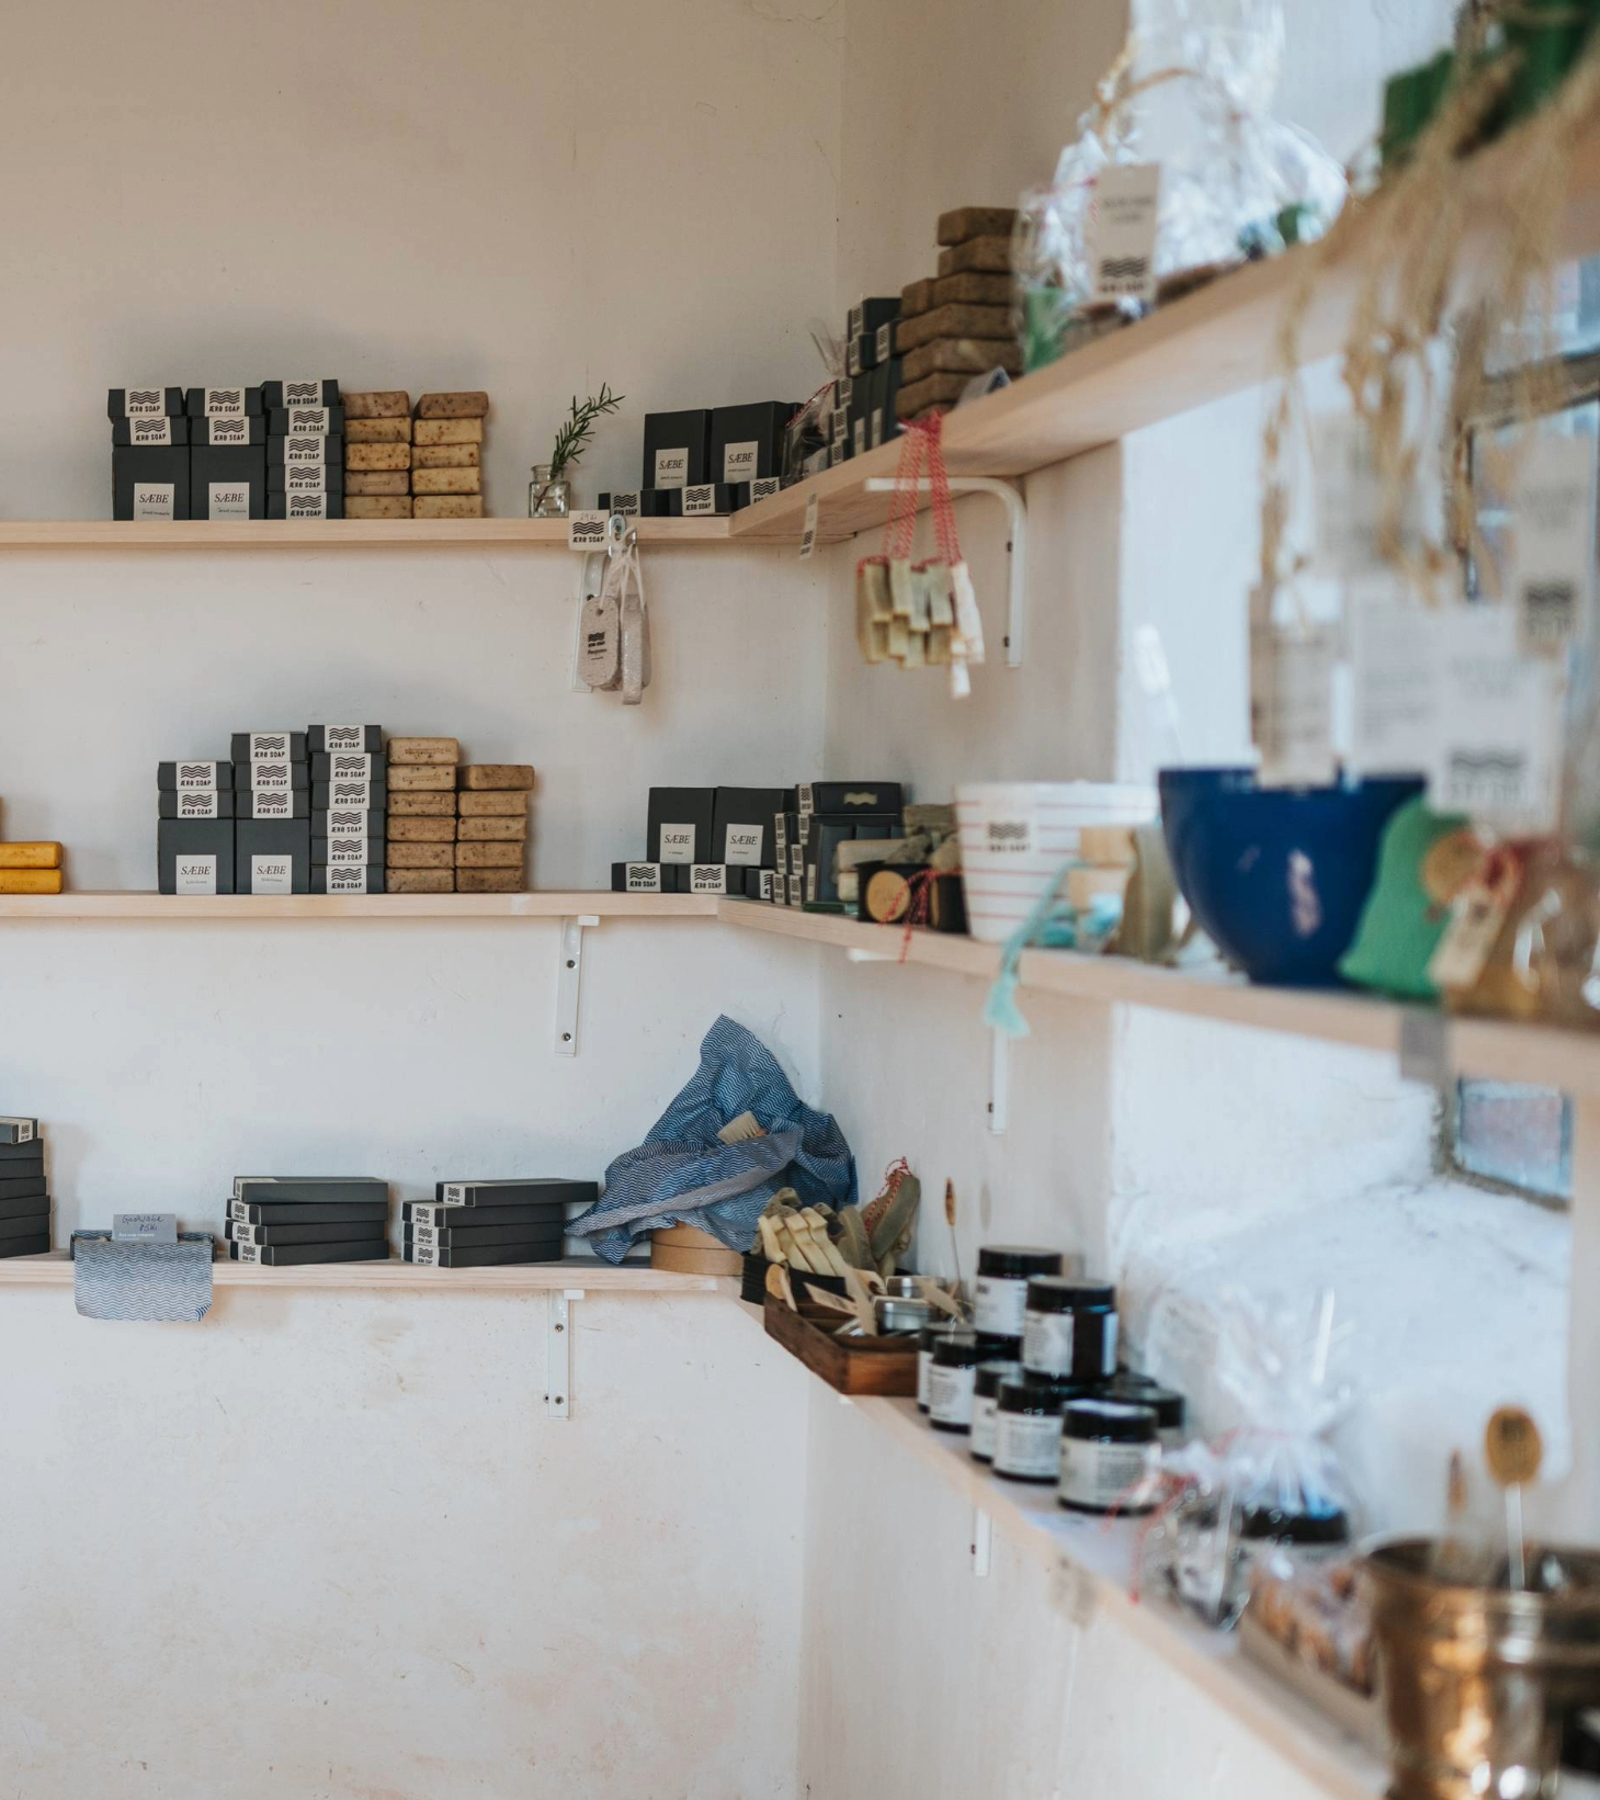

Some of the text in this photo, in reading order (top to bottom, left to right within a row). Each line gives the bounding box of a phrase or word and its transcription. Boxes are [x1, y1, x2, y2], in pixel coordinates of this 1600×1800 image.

[144, 405, 161, 413] SOAP
[727, 452, 754, 464] SÆBE
[658, 458, 684, 470] SÆBE
[138, 494, 170, 504] SÆBE
[214, 493, 244, 503] SÆBE
[344, 741, 360, 749] SOAP
[195, 779, 212, 787] SOAP
[664, 834, 691, 844] SÆBE
[730, 835, 758, 846] SÆBE
[181, 866, 210, 875] SÆBE
[256, 865, 286, 875] SÆBE
[642, 880, 657, 888] SOAP
